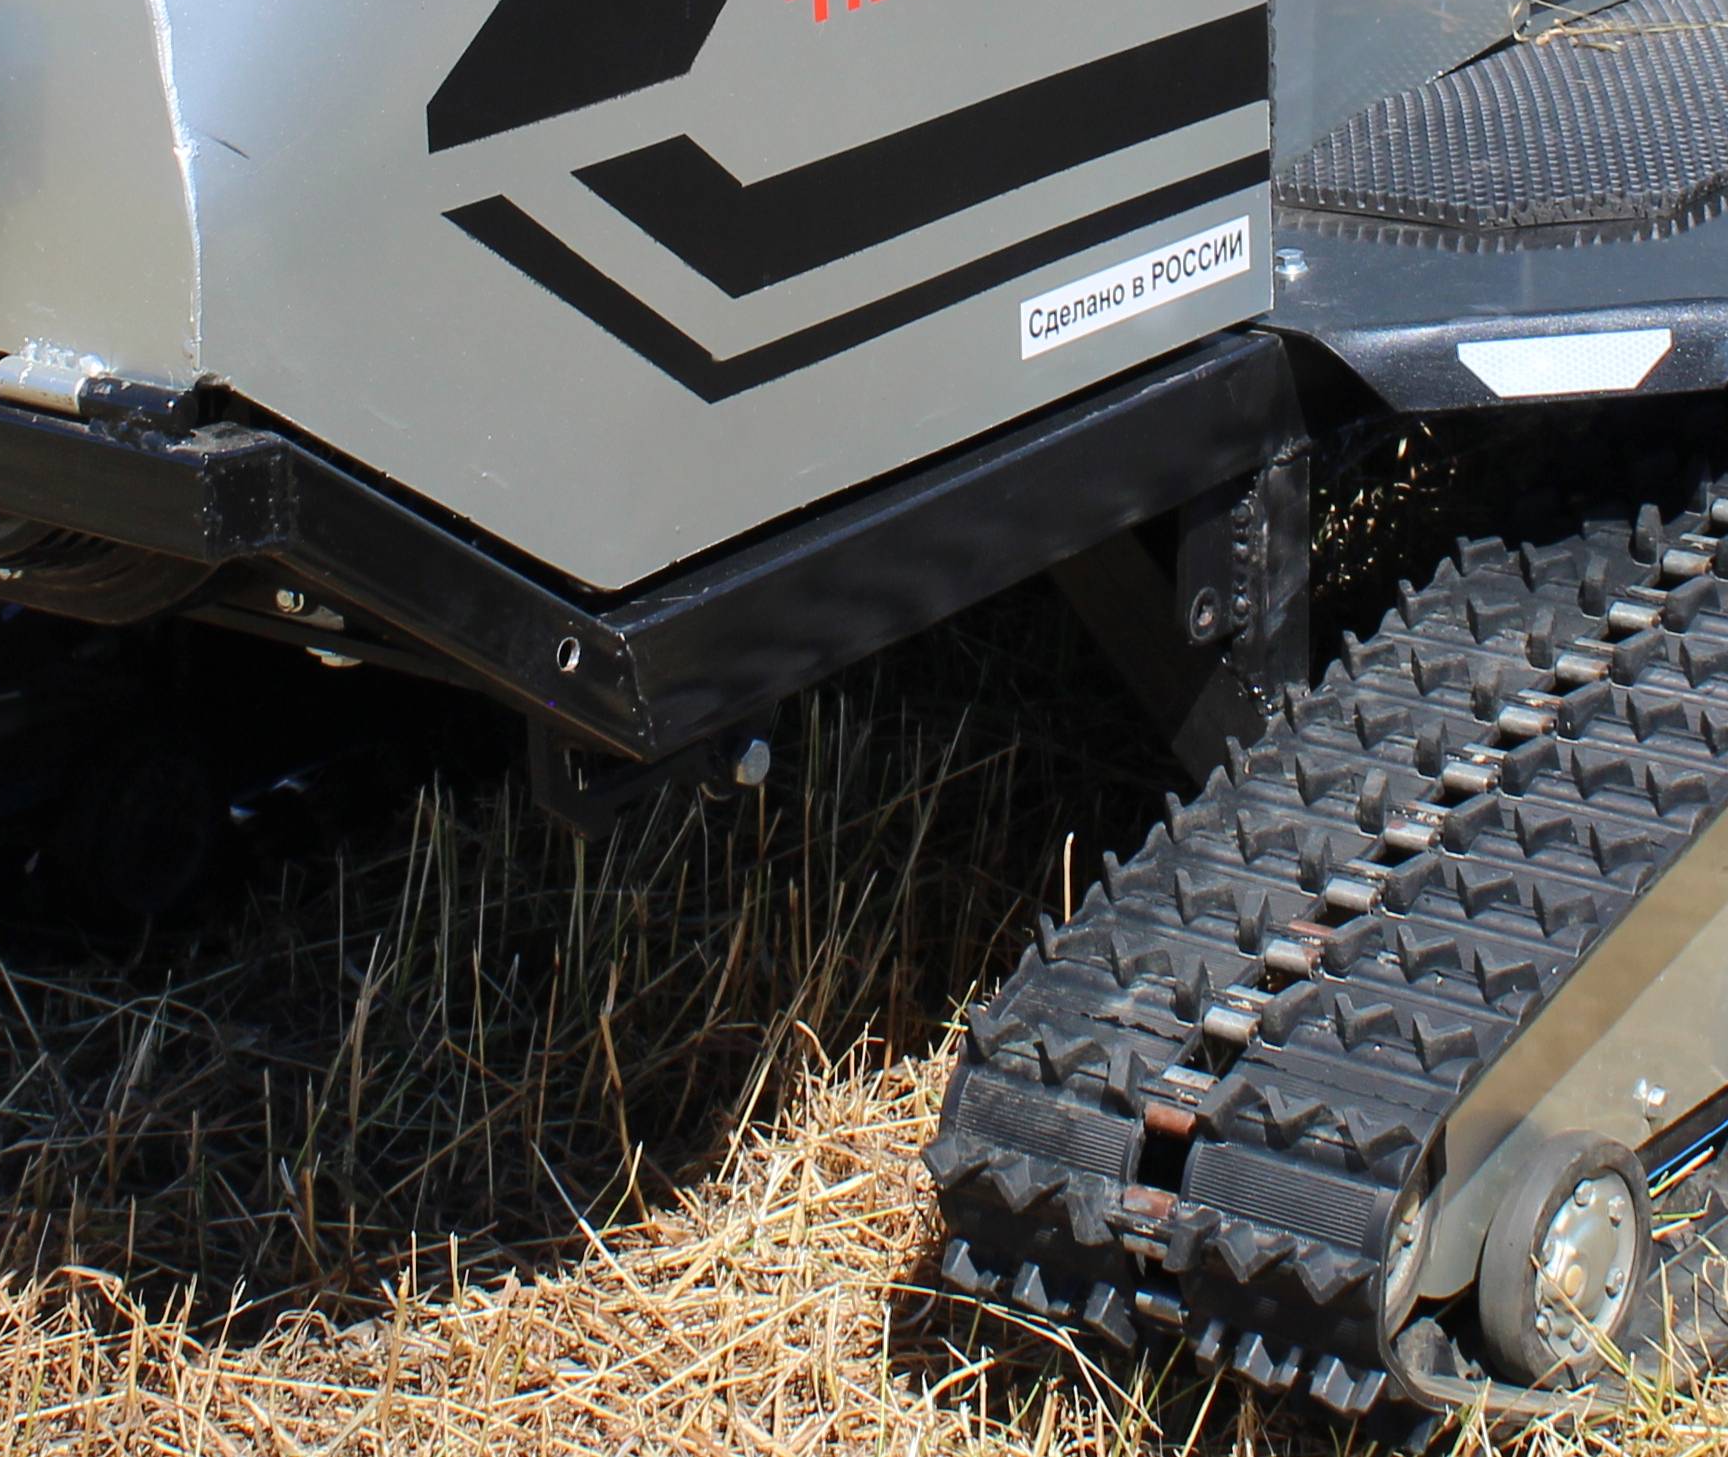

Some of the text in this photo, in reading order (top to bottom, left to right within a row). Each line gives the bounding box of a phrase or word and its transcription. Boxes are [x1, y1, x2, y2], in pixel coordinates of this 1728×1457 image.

[1029, 229, 1243, 339] Сделано в РОССИИ
